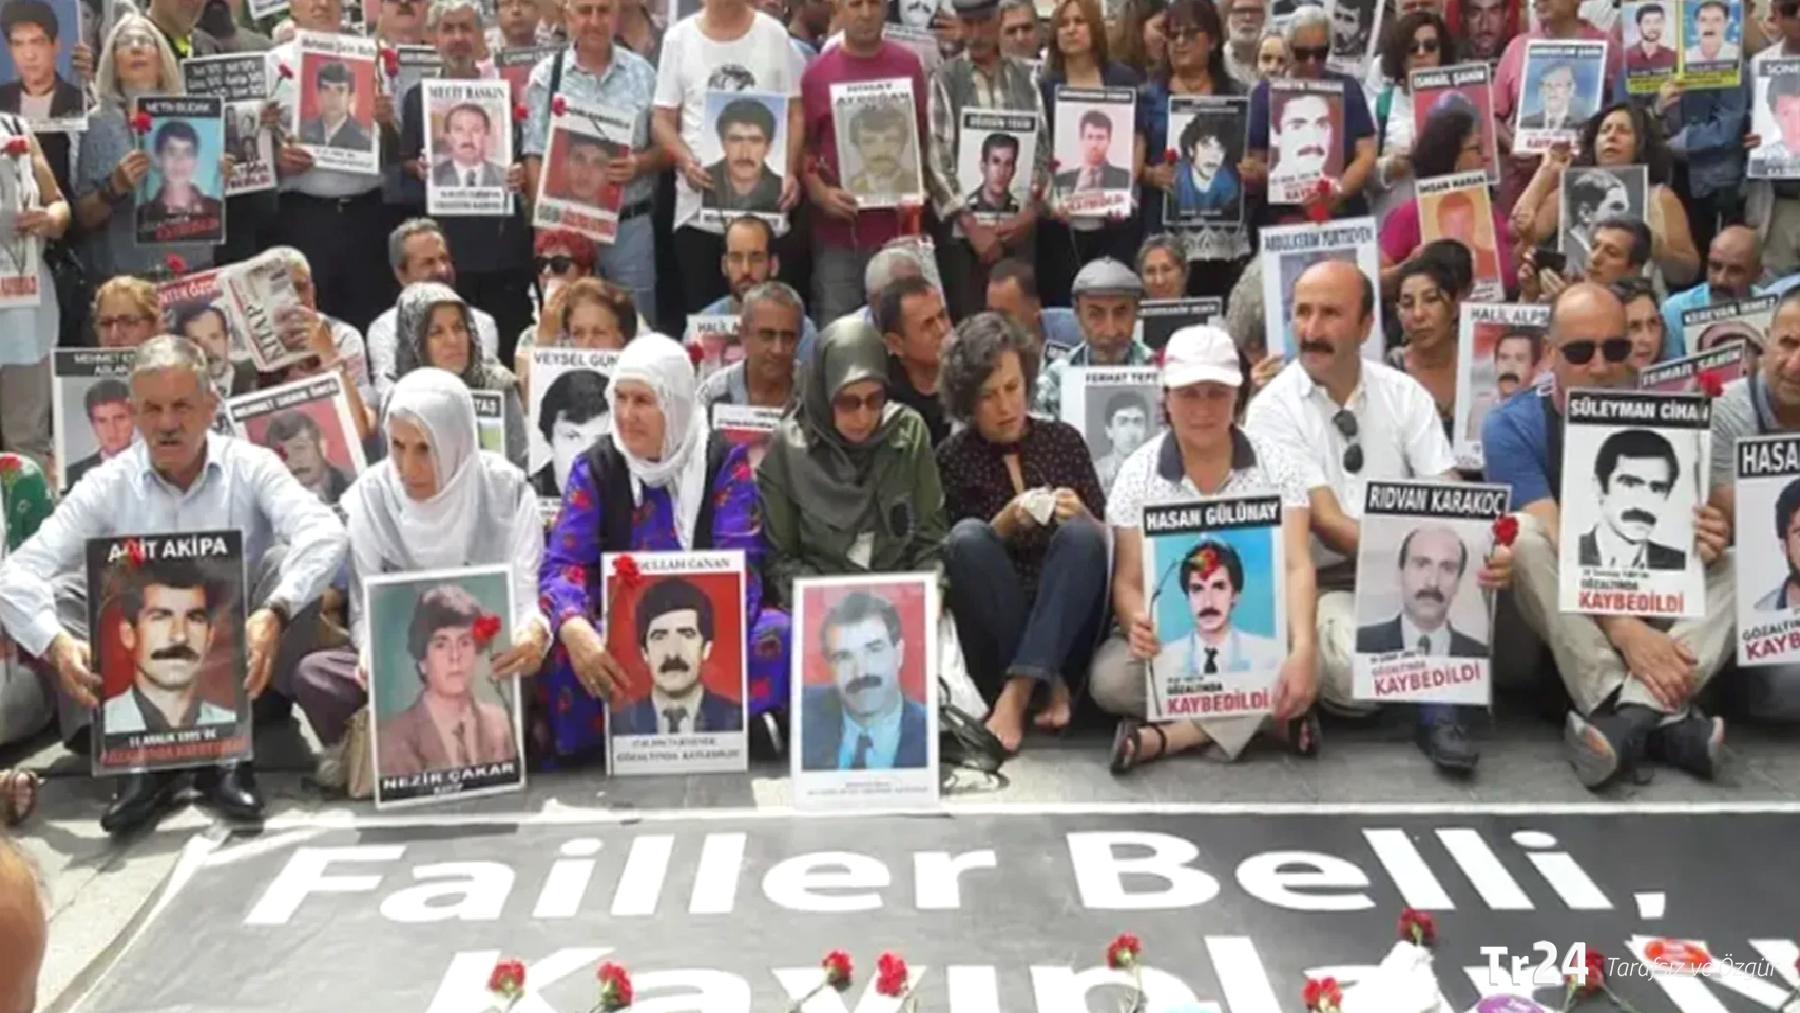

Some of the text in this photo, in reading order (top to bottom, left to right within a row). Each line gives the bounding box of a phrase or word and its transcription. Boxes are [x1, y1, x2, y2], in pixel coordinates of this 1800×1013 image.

[534, 353, 586, 366] VEYSEL
[1570, 397, 1656, 417] SÜLEYMAN
[1370, 486, 1426, 510] RIDVAN
[1146, 500, 1278, 531] HASAN GÜLÜNAY
[163, 535, 228, 559] AKİPA
[1579, 589, 1684, 613] KAYBEDİLDİ
[1374, 661, 1480, 695] KAYBEDİLDİ
[1167, 688, 1269, 713] KAYBEDİLDİ
[383, 772, 443, 789] NEZİR
[244, 828, 1667, 926] Failler Belli,
